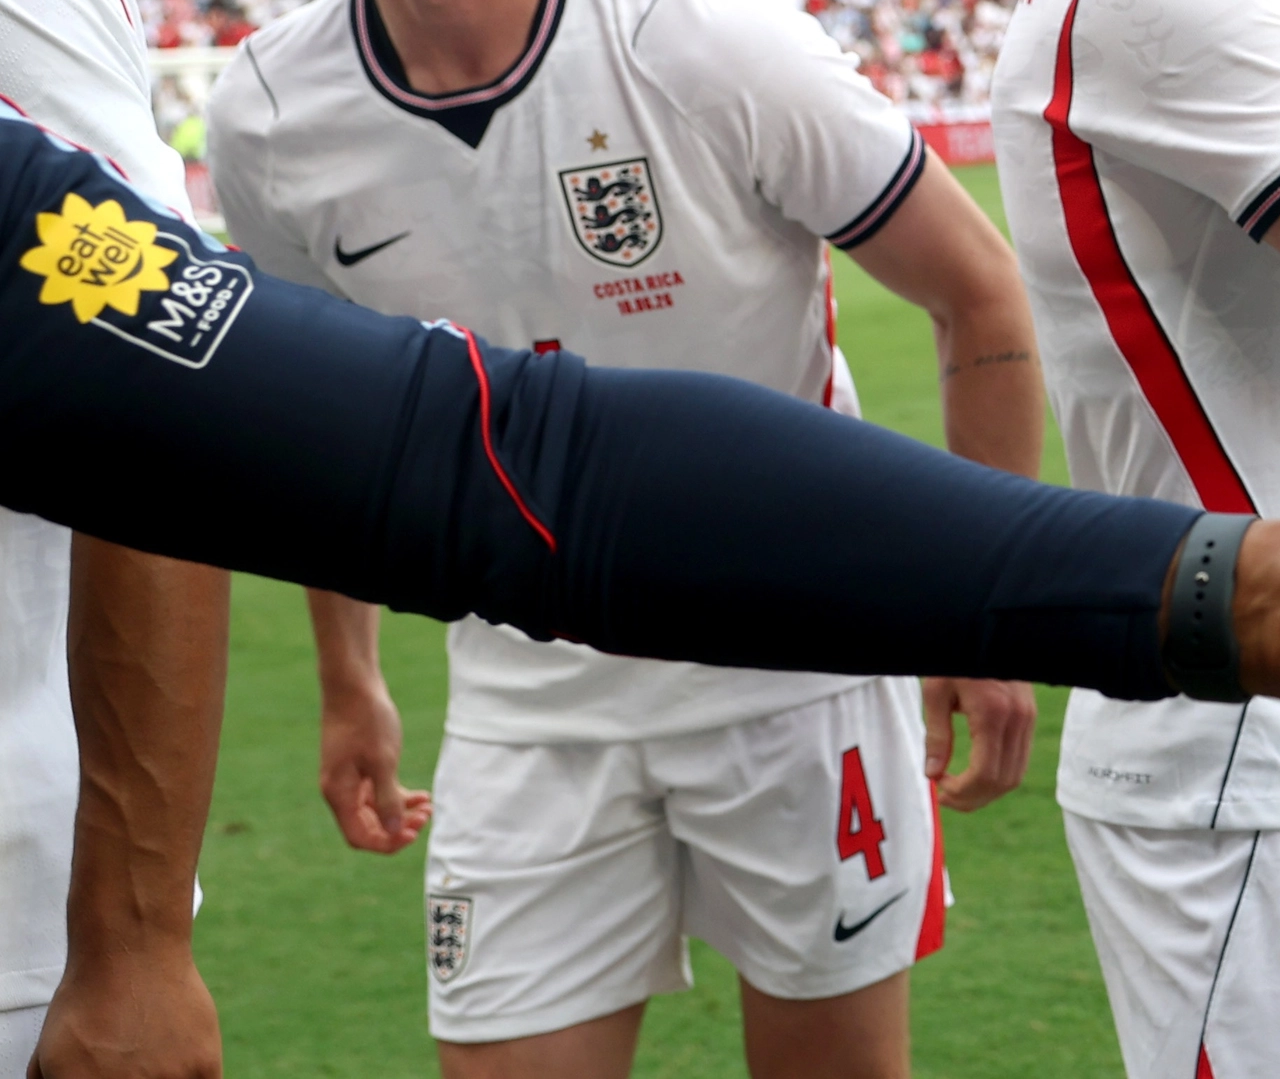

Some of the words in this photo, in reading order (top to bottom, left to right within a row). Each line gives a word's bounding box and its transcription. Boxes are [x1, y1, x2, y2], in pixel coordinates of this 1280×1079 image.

[57, 223, 99, 277] eat
[81, 226, 139, 287] well
[147, 266, 222, 342] M&S
[593, 276, 644, 300] COSTA
[645, 270, 685, 291] RICA
[837, 746, 887, 882] 4
